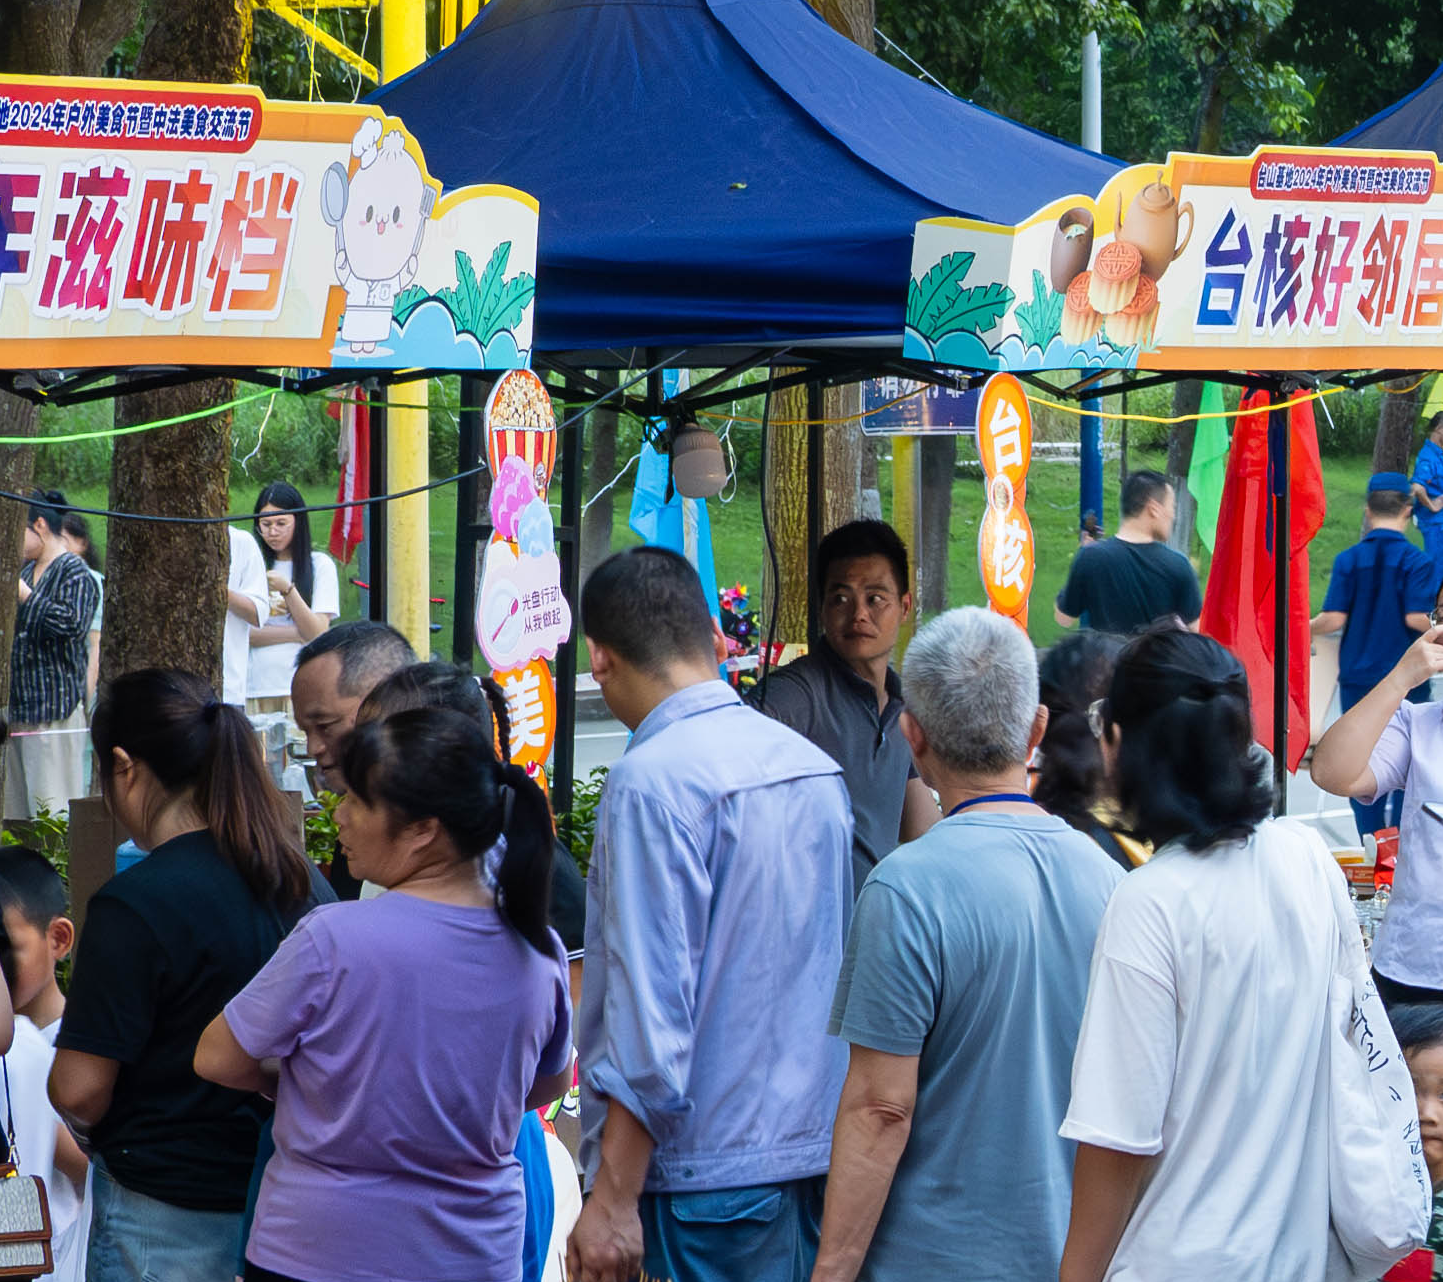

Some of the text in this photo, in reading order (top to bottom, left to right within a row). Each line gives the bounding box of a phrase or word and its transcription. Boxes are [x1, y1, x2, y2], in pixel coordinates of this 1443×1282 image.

[1256, 162, 1430, 196] 台山基地2024年户外美食节暨中法美食交流节
[522, 586, 560, 613] 光盘行动
[523, 607, 562, 634] 从我做起
[503, 669, 546, 759] 美
